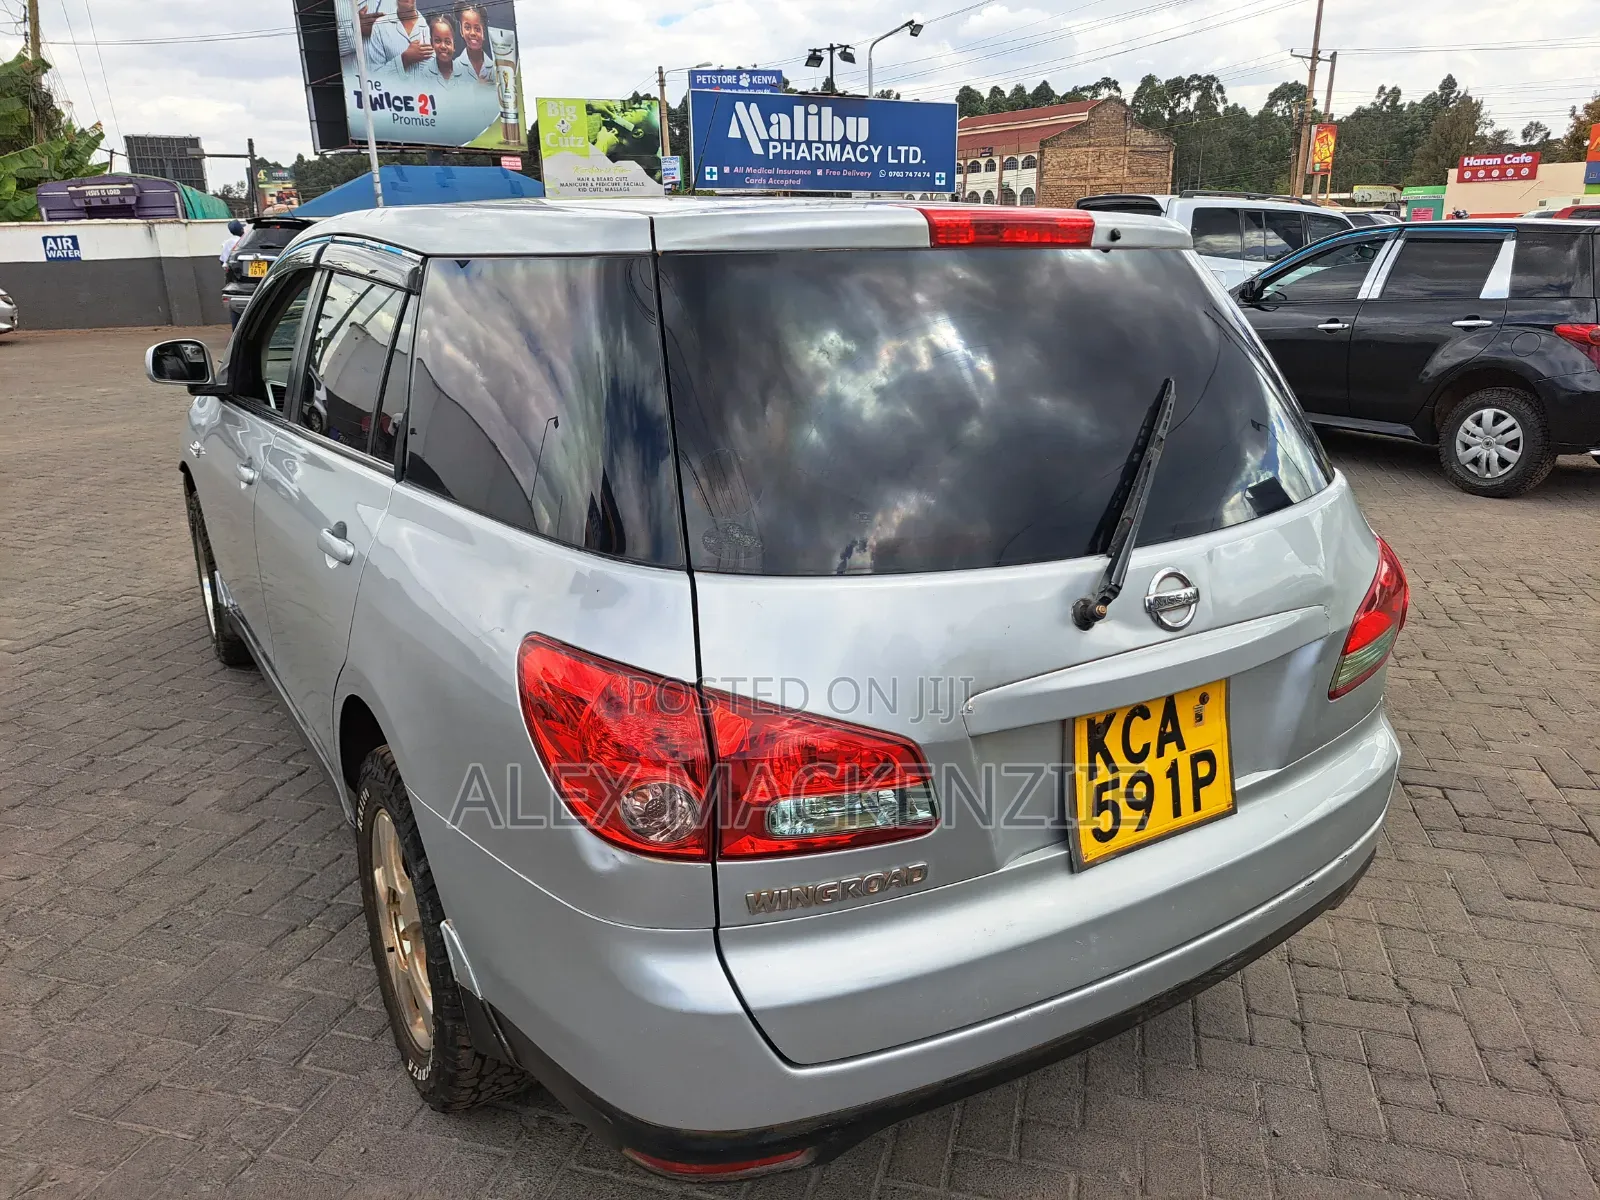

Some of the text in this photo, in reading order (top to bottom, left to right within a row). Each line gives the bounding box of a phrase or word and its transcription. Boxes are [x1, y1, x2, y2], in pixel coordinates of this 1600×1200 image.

[696, 75, 777, 84] PETSTORE KENYA
[418, 93, 437, 116] 2!
[547, 101, 578, 122] Big
[392, 113, 436, 127] Promise
[728, 101, 869, 155] Malibu
[545, 132, 585, 148] Cutz
[768, 141, 926, 164] PHARMACY LTD.
[1463, 156, 1501, 167] Haran
[1503, 153, 1533, 164] Cafe
[733, 166, 812, 176] All Medical Insurance
[825, 168, 872, 178] Free Delivery
[745, 176, 801, 186] Cards Accepted
[85, 189, 100, 197] JESUS
[46, 237, 74, 250] AIR
[46, 250, 80, 258] WATER
[1154, 591, 1198, 609] NISSAN
[1087, 694, 1186, 783] KCA
[1092, 748, 1217, 844] 591P
[745, 861, 928, 915] WINGROAD
